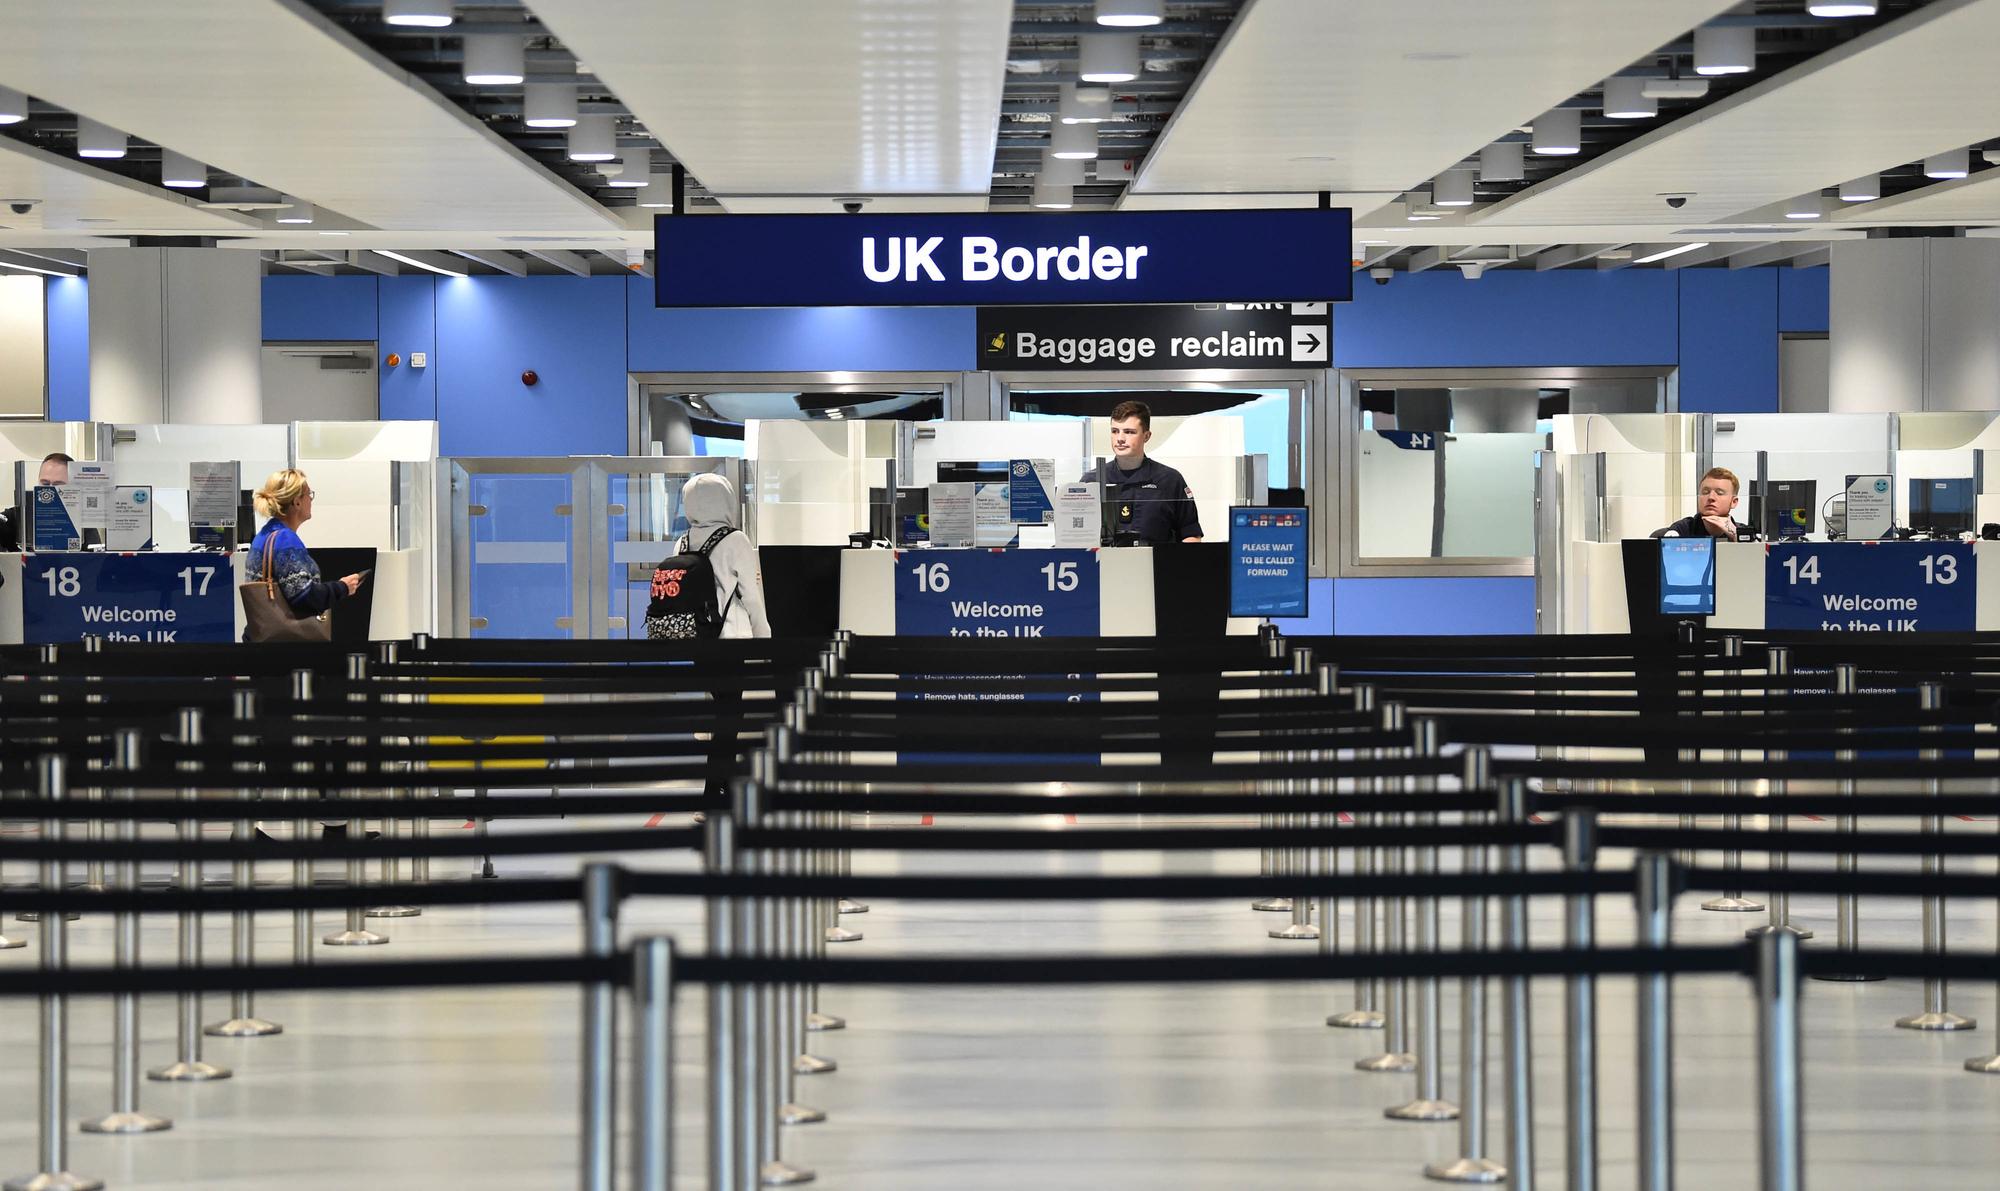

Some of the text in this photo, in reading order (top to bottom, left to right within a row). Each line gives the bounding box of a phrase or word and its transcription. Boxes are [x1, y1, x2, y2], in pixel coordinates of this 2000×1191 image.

[862, 235, 1147, 282] UK Border
[1017, 331, 1284, 363] Baggage reclaim
[1241, 557, 1295, 565] TO BE CALLED
[1242, 543, 1294, 551] PLEASE WAIT
[41, 567, 81, 597] 18
[177, 566, 216, 596] 17
[912, 562, 950, 593] 16
[1040, 562, 1079, 592] 15
[1247, 569, 1288, 577] FORWARD
[1782, 555, 1822, 585] 14
[1918, 554, 1958, 585] 13
[81, 605, 177, 622] Welcome
[951, 601, 1044, 618] Welcome
[1822, 594, 1918, 611] Welcome
[924, 693, 1025, 702] Remove hats, sunglasses
